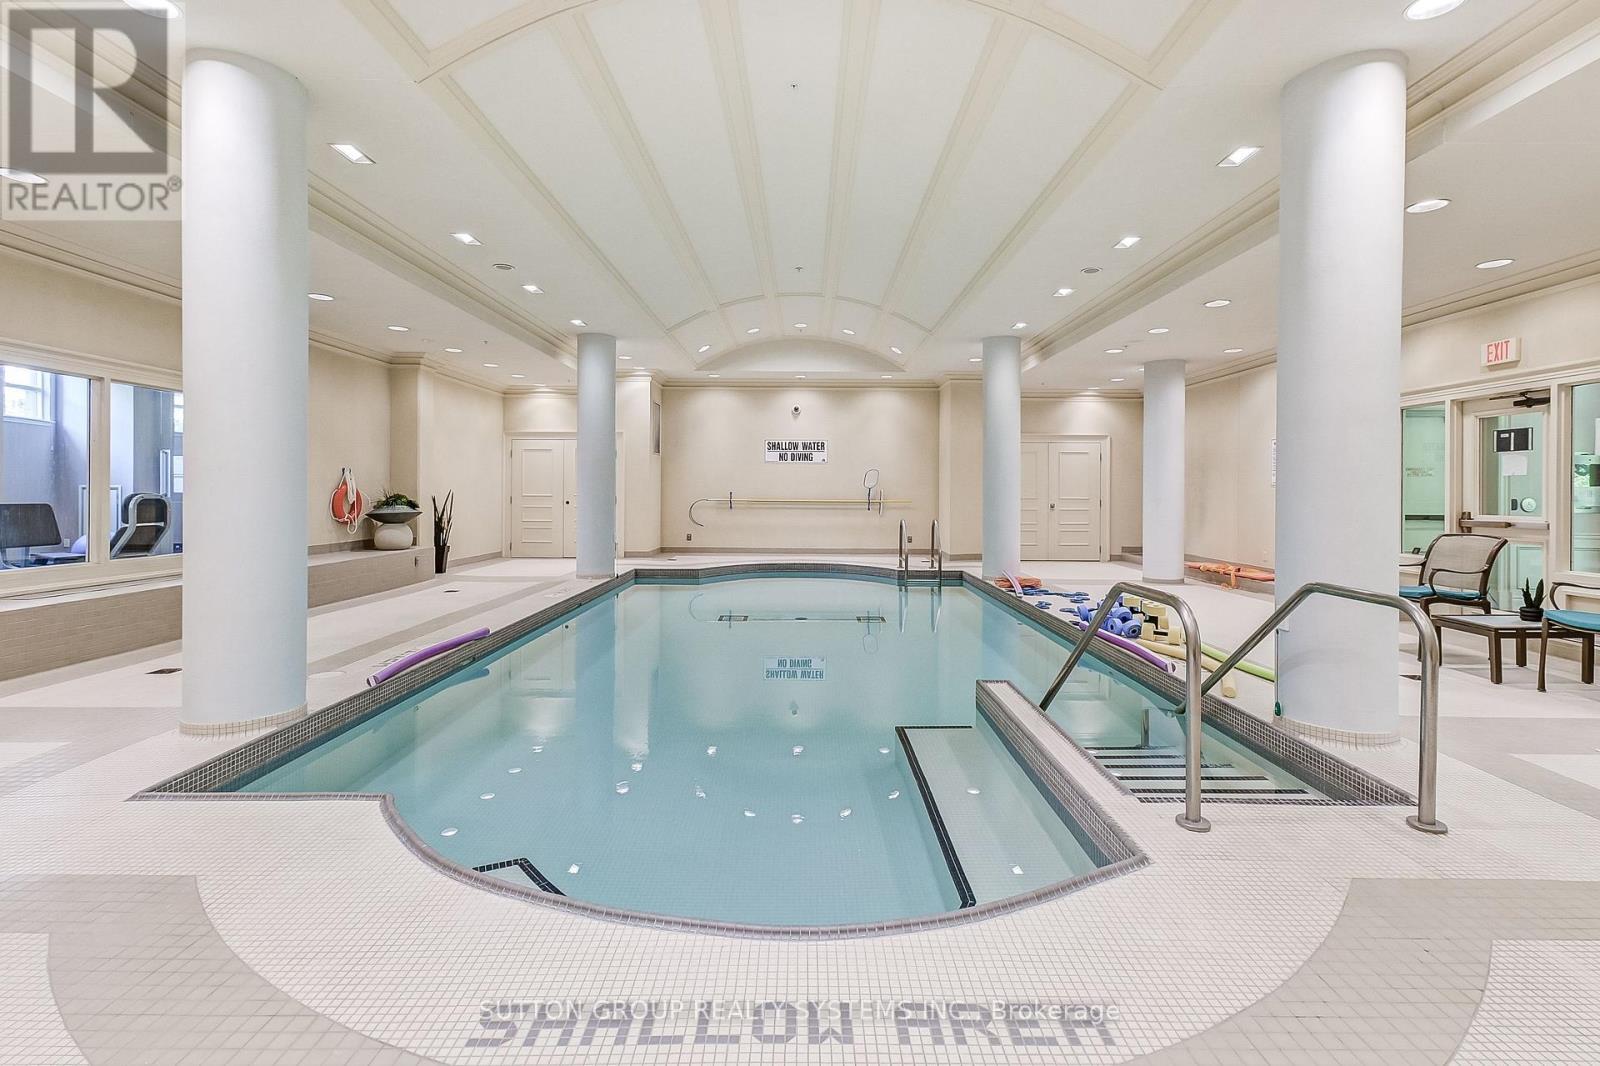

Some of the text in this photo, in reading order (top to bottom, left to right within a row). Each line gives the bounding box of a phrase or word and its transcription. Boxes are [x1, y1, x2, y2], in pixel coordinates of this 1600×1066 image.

[1487, 340, 1511, 363] EXIT
[767, 441, 826, 451] SHALLOW WATER
[779, 452, 814, 462] NO DIVING
[465, 1001, 1117, 1047] SHALLOW AREA
